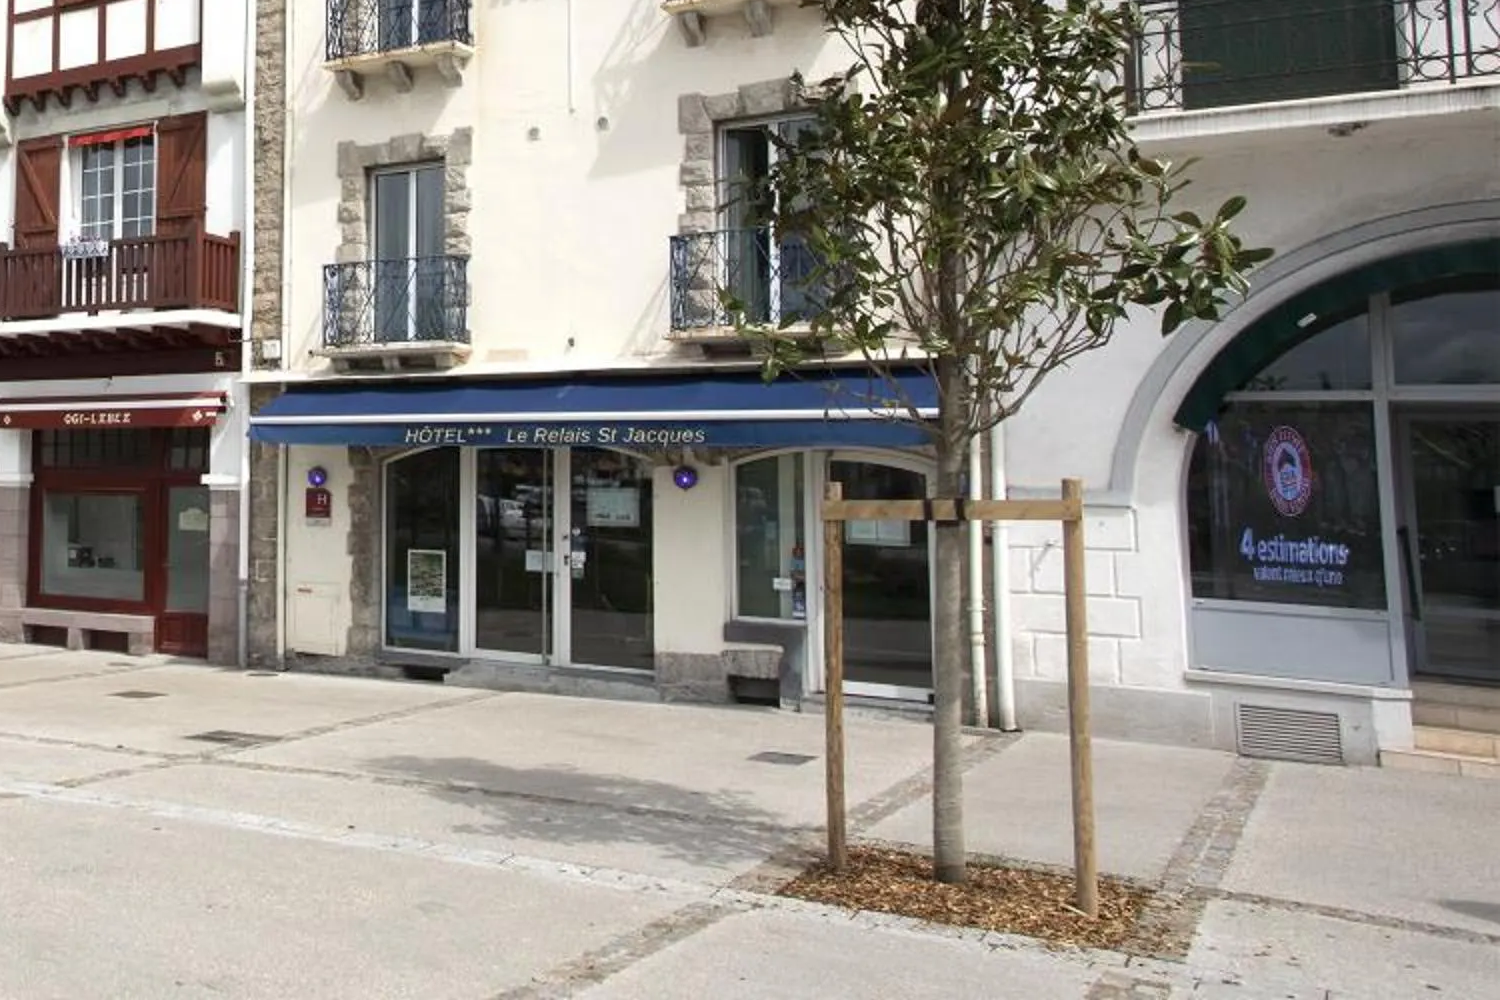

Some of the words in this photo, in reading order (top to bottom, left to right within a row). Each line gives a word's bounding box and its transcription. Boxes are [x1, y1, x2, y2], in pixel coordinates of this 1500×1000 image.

[506, 427, 527, 443] Le
[534, 426, 592, 443] Relais
[597, 426, 618, 443] St
[622, 427, 706, 446] Jacques
[317, 493, 328, 505] H
[1240, 527, 1255, 561] 4
[1257, 534, 1351, 565] estimations
